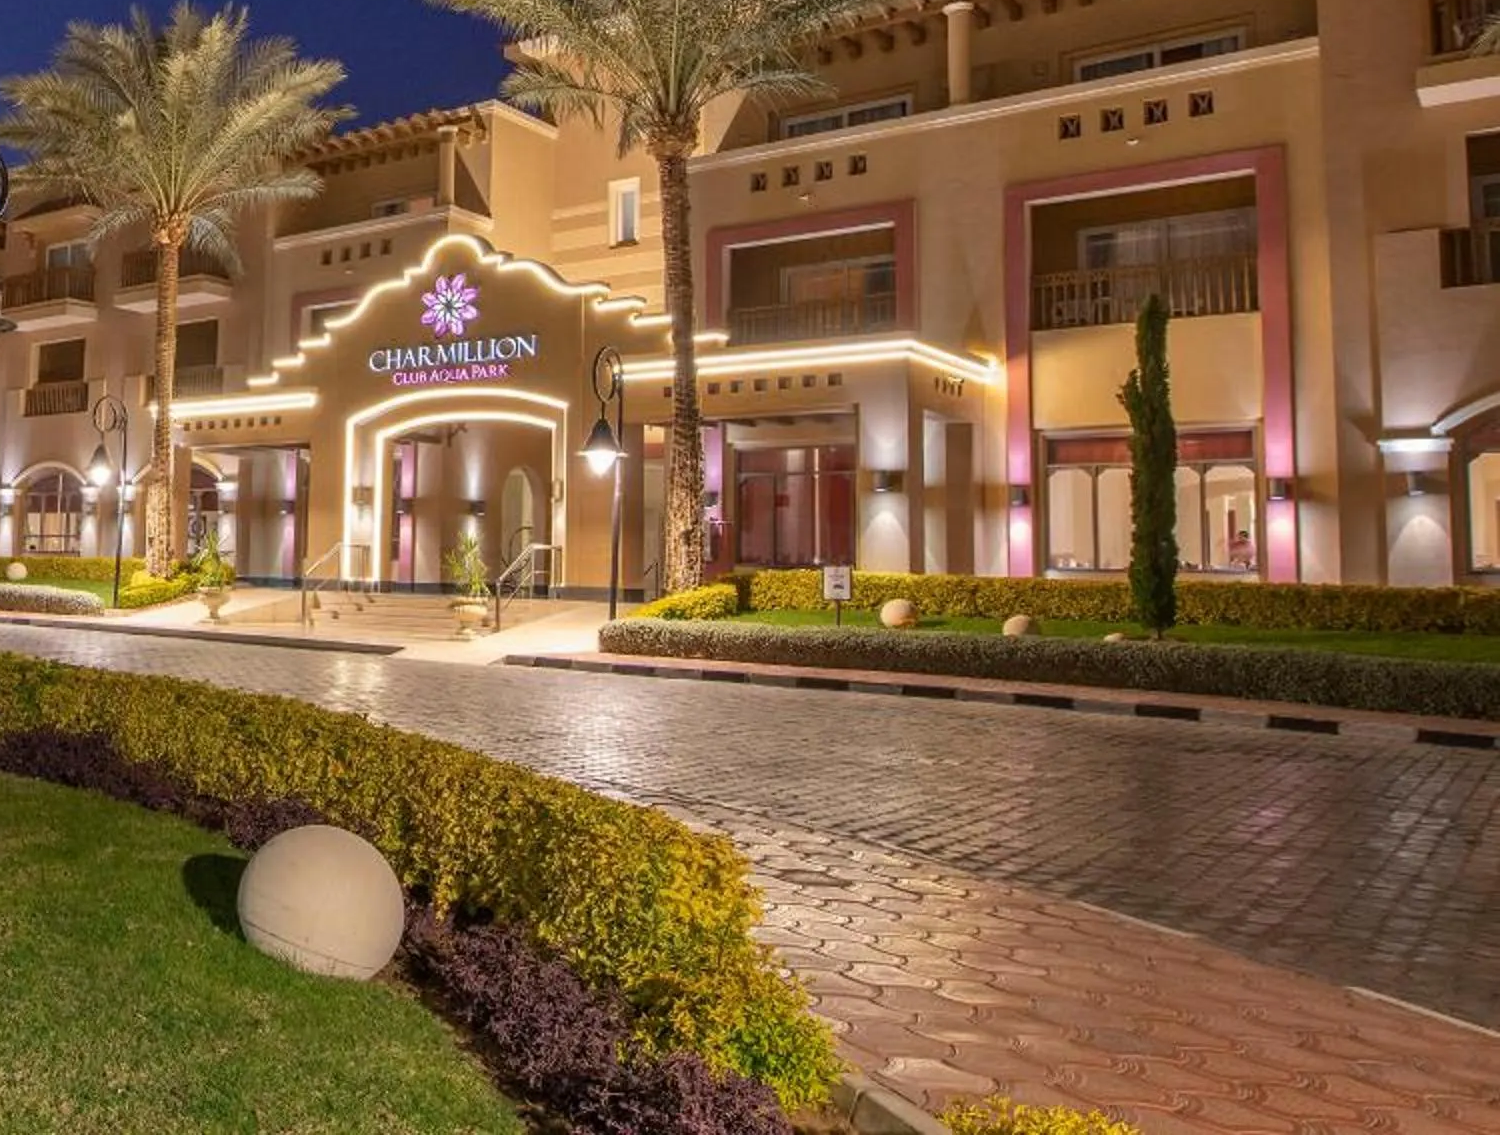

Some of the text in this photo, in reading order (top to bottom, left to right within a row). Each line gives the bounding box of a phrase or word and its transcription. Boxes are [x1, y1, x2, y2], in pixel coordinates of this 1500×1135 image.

[369, 335, 538, 372] CHARMILLION
[393, 364, 509, 385] CLUB AQUA PARK
